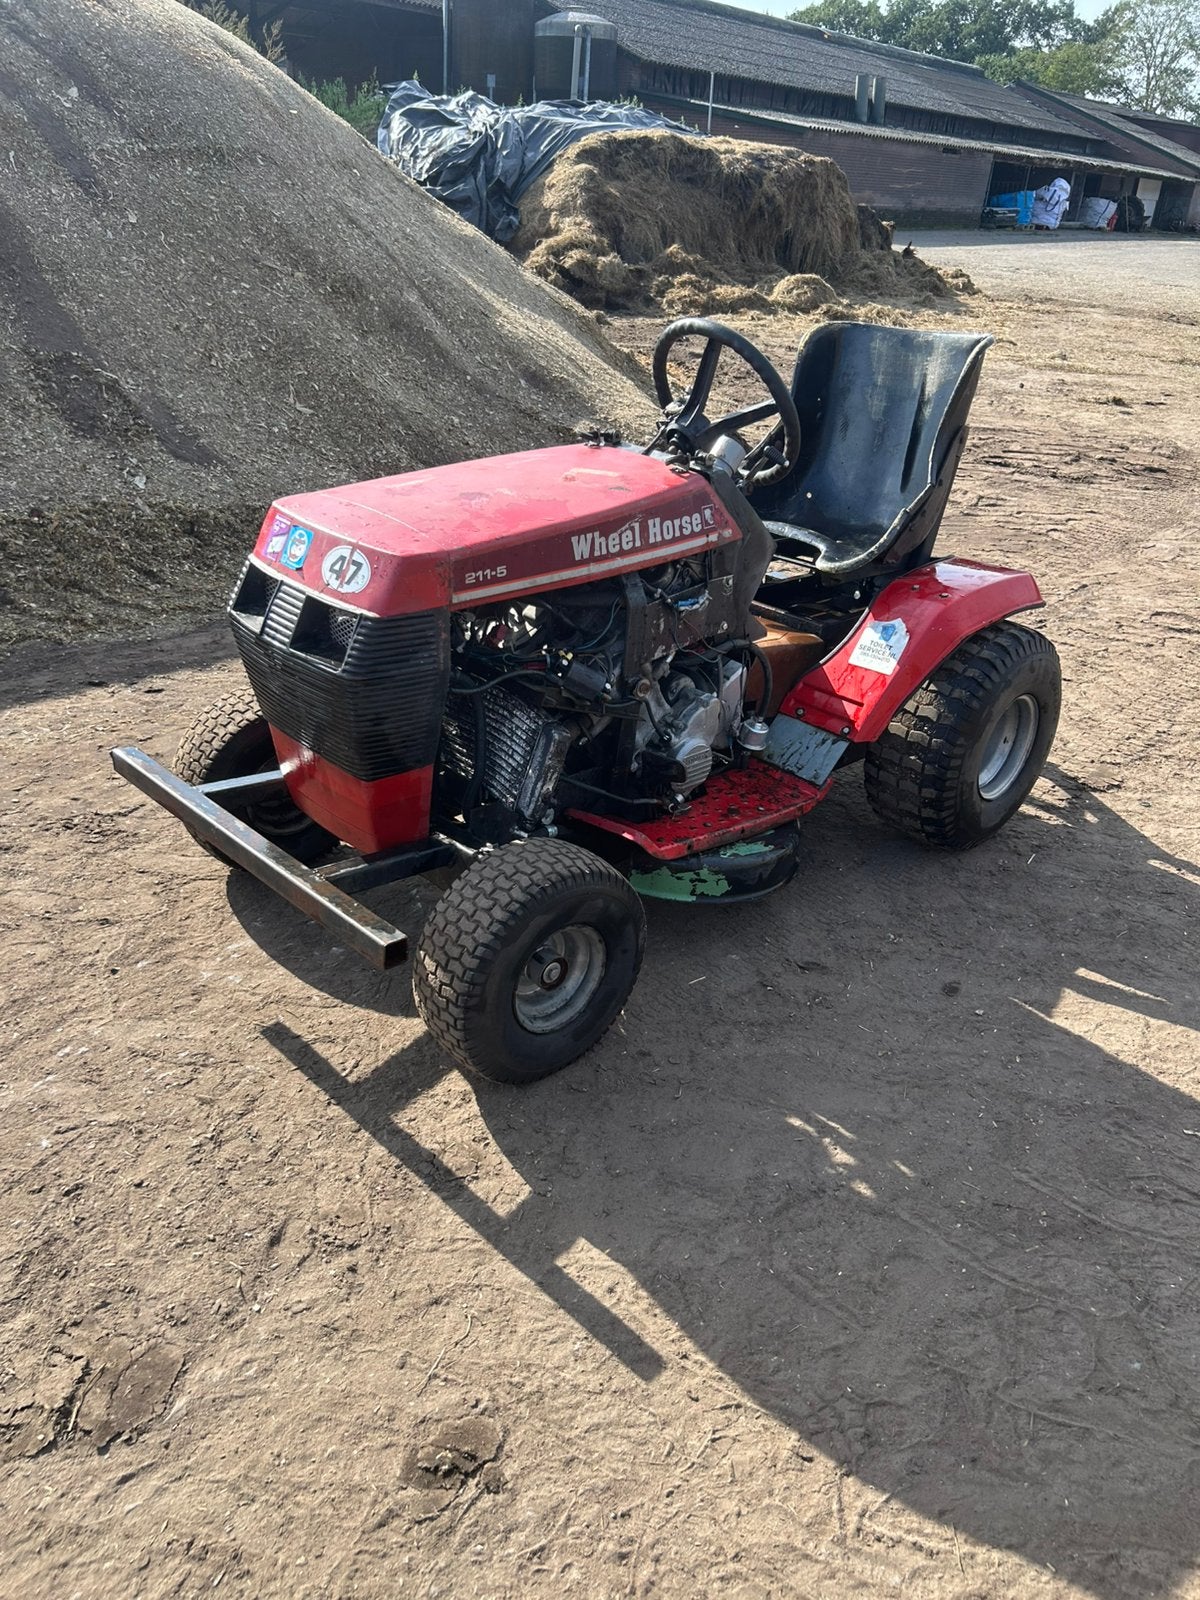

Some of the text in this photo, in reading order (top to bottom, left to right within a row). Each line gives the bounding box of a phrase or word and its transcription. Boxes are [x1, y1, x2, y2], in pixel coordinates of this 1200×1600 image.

[571, 512, 702, 561] Wheel Horse
[329, 554, 363, 586] 47
[464, 565, 507, 584] 211-5
